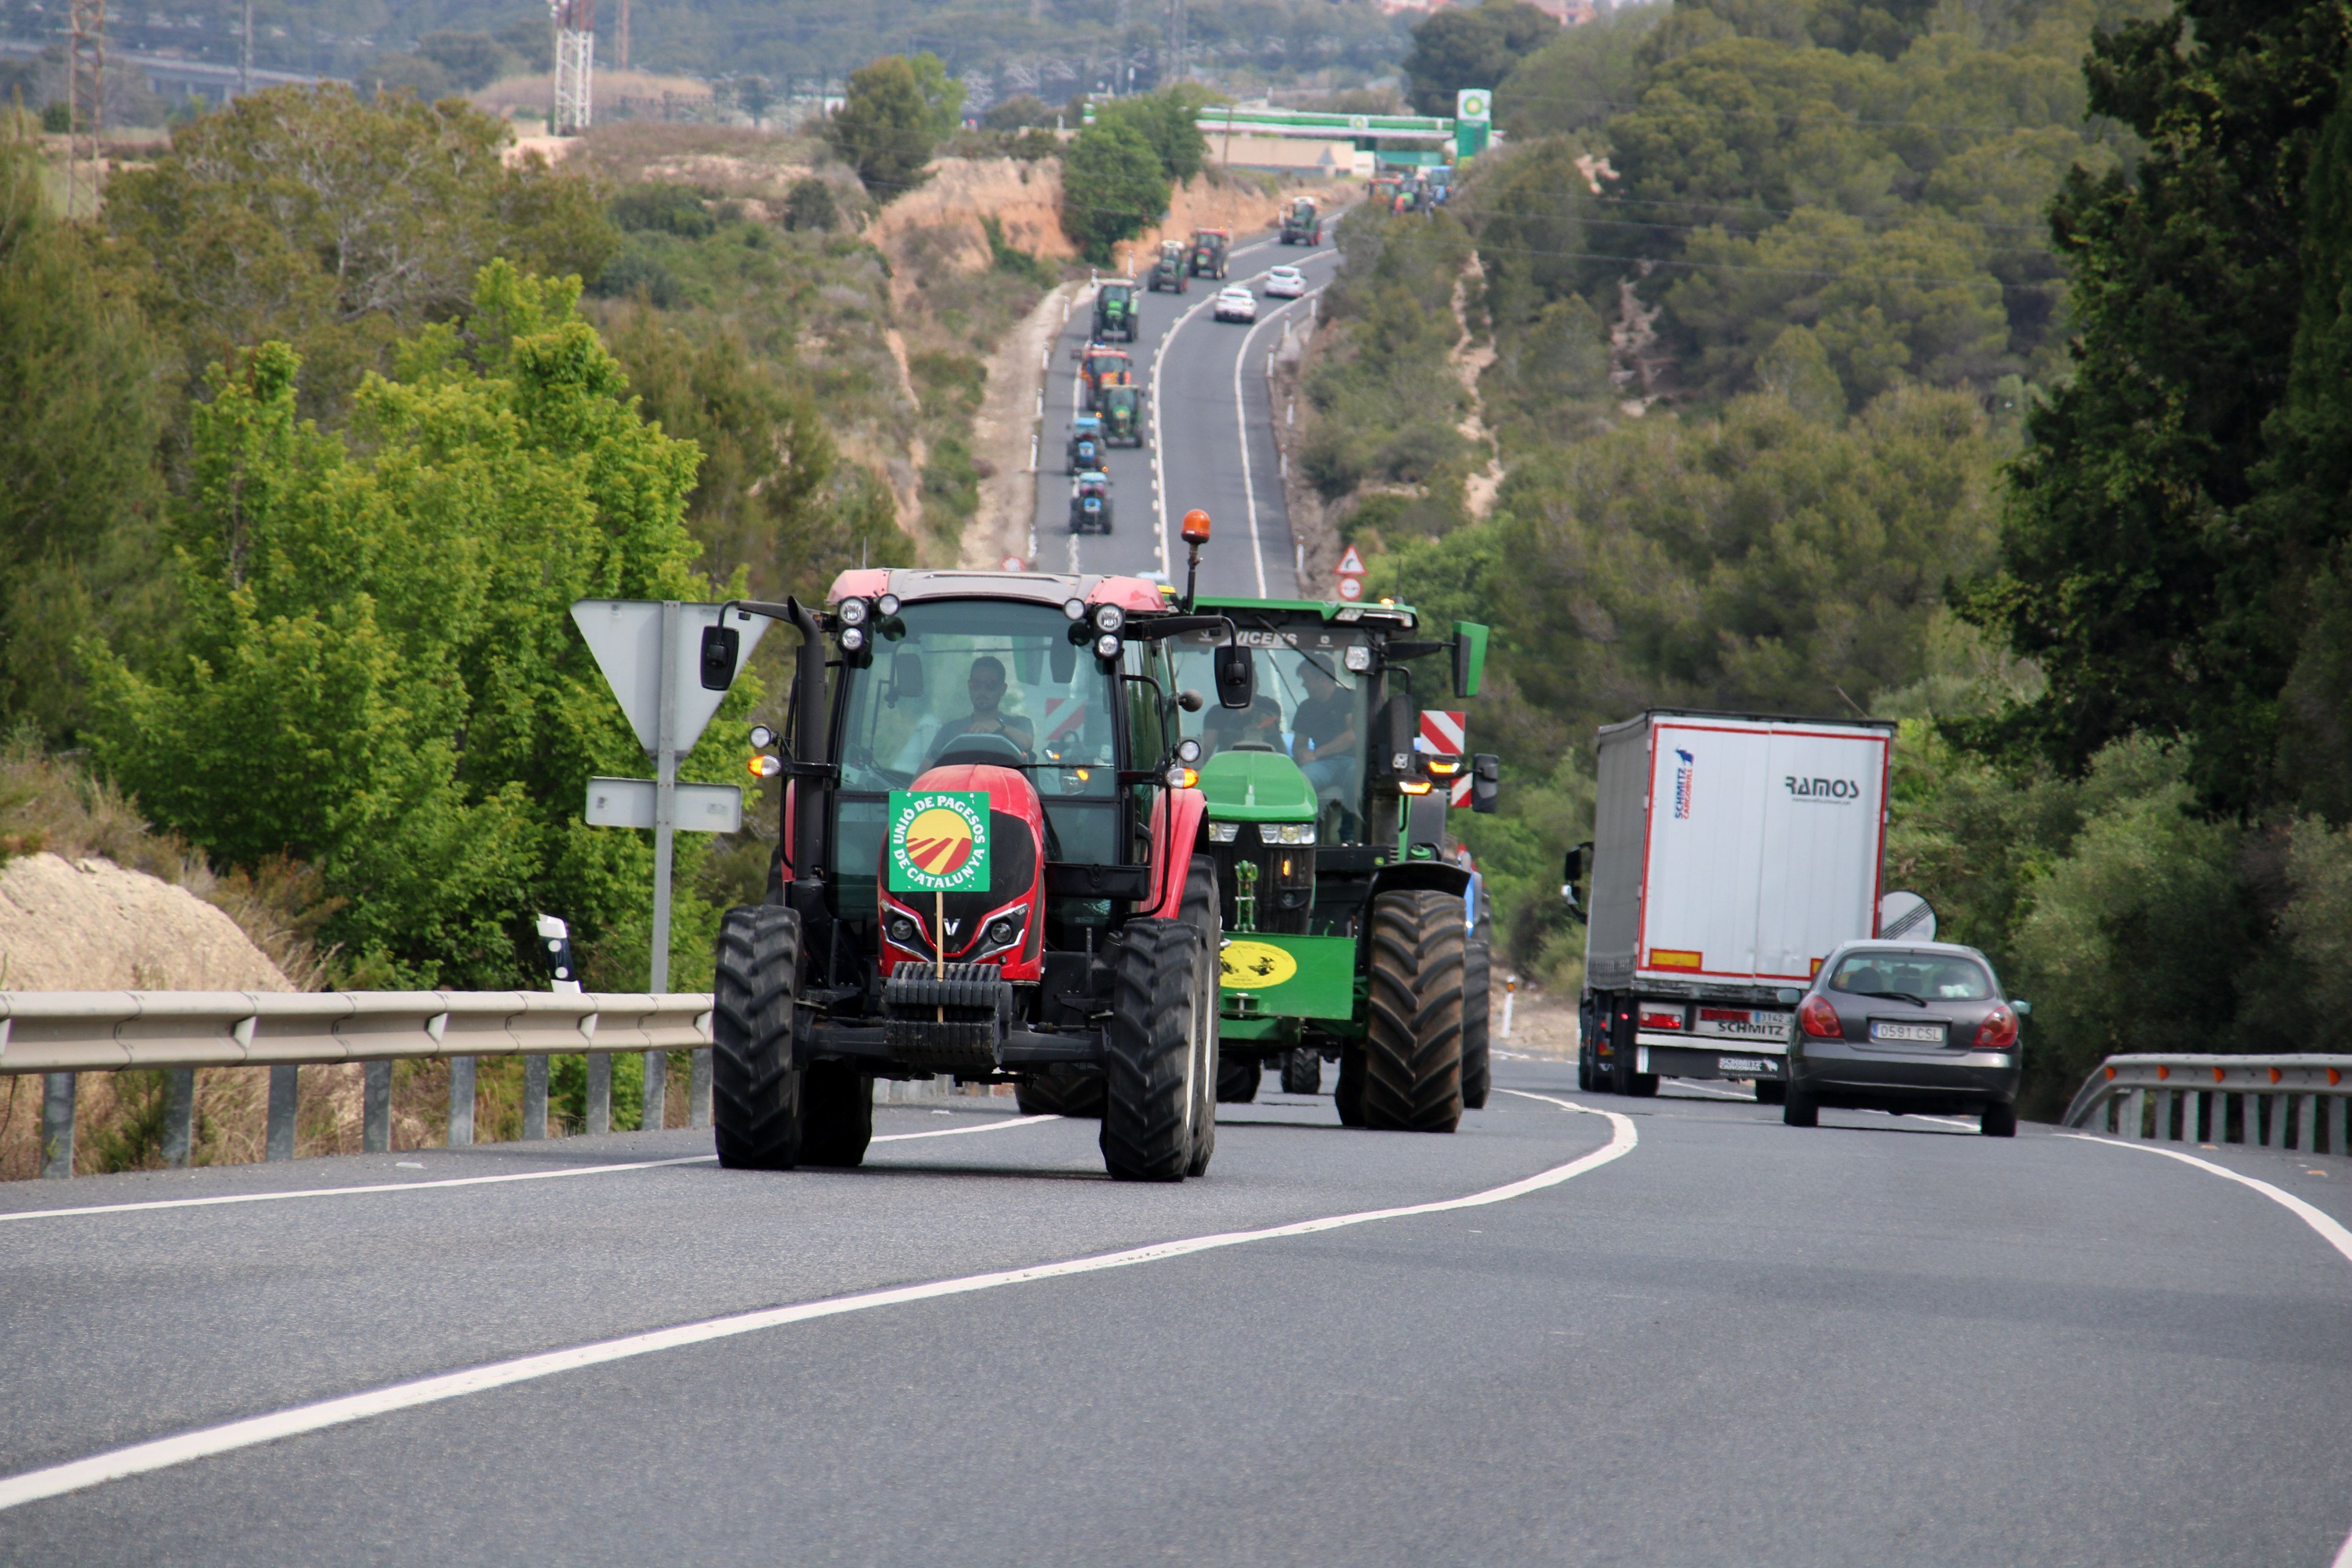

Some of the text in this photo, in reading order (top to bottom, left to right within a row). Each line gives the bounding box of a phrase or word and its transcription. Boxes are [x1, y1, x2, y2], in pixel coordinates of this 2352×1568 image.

[1675, 768, 1686, 819] SCHMITZ
[1785, 776, 1860, 798] RAMOS
[893, 795, 986, 844] UNIÓ DE PAGESOS
[894, 848, 985, 888] DE CATALUNYA
[1718, 1021, 1784, 1036] SCHMITZ
[1762, 1014, 1784, 1023] 3142
[1881, 1025, 1940, 1040] 0591 CSL
